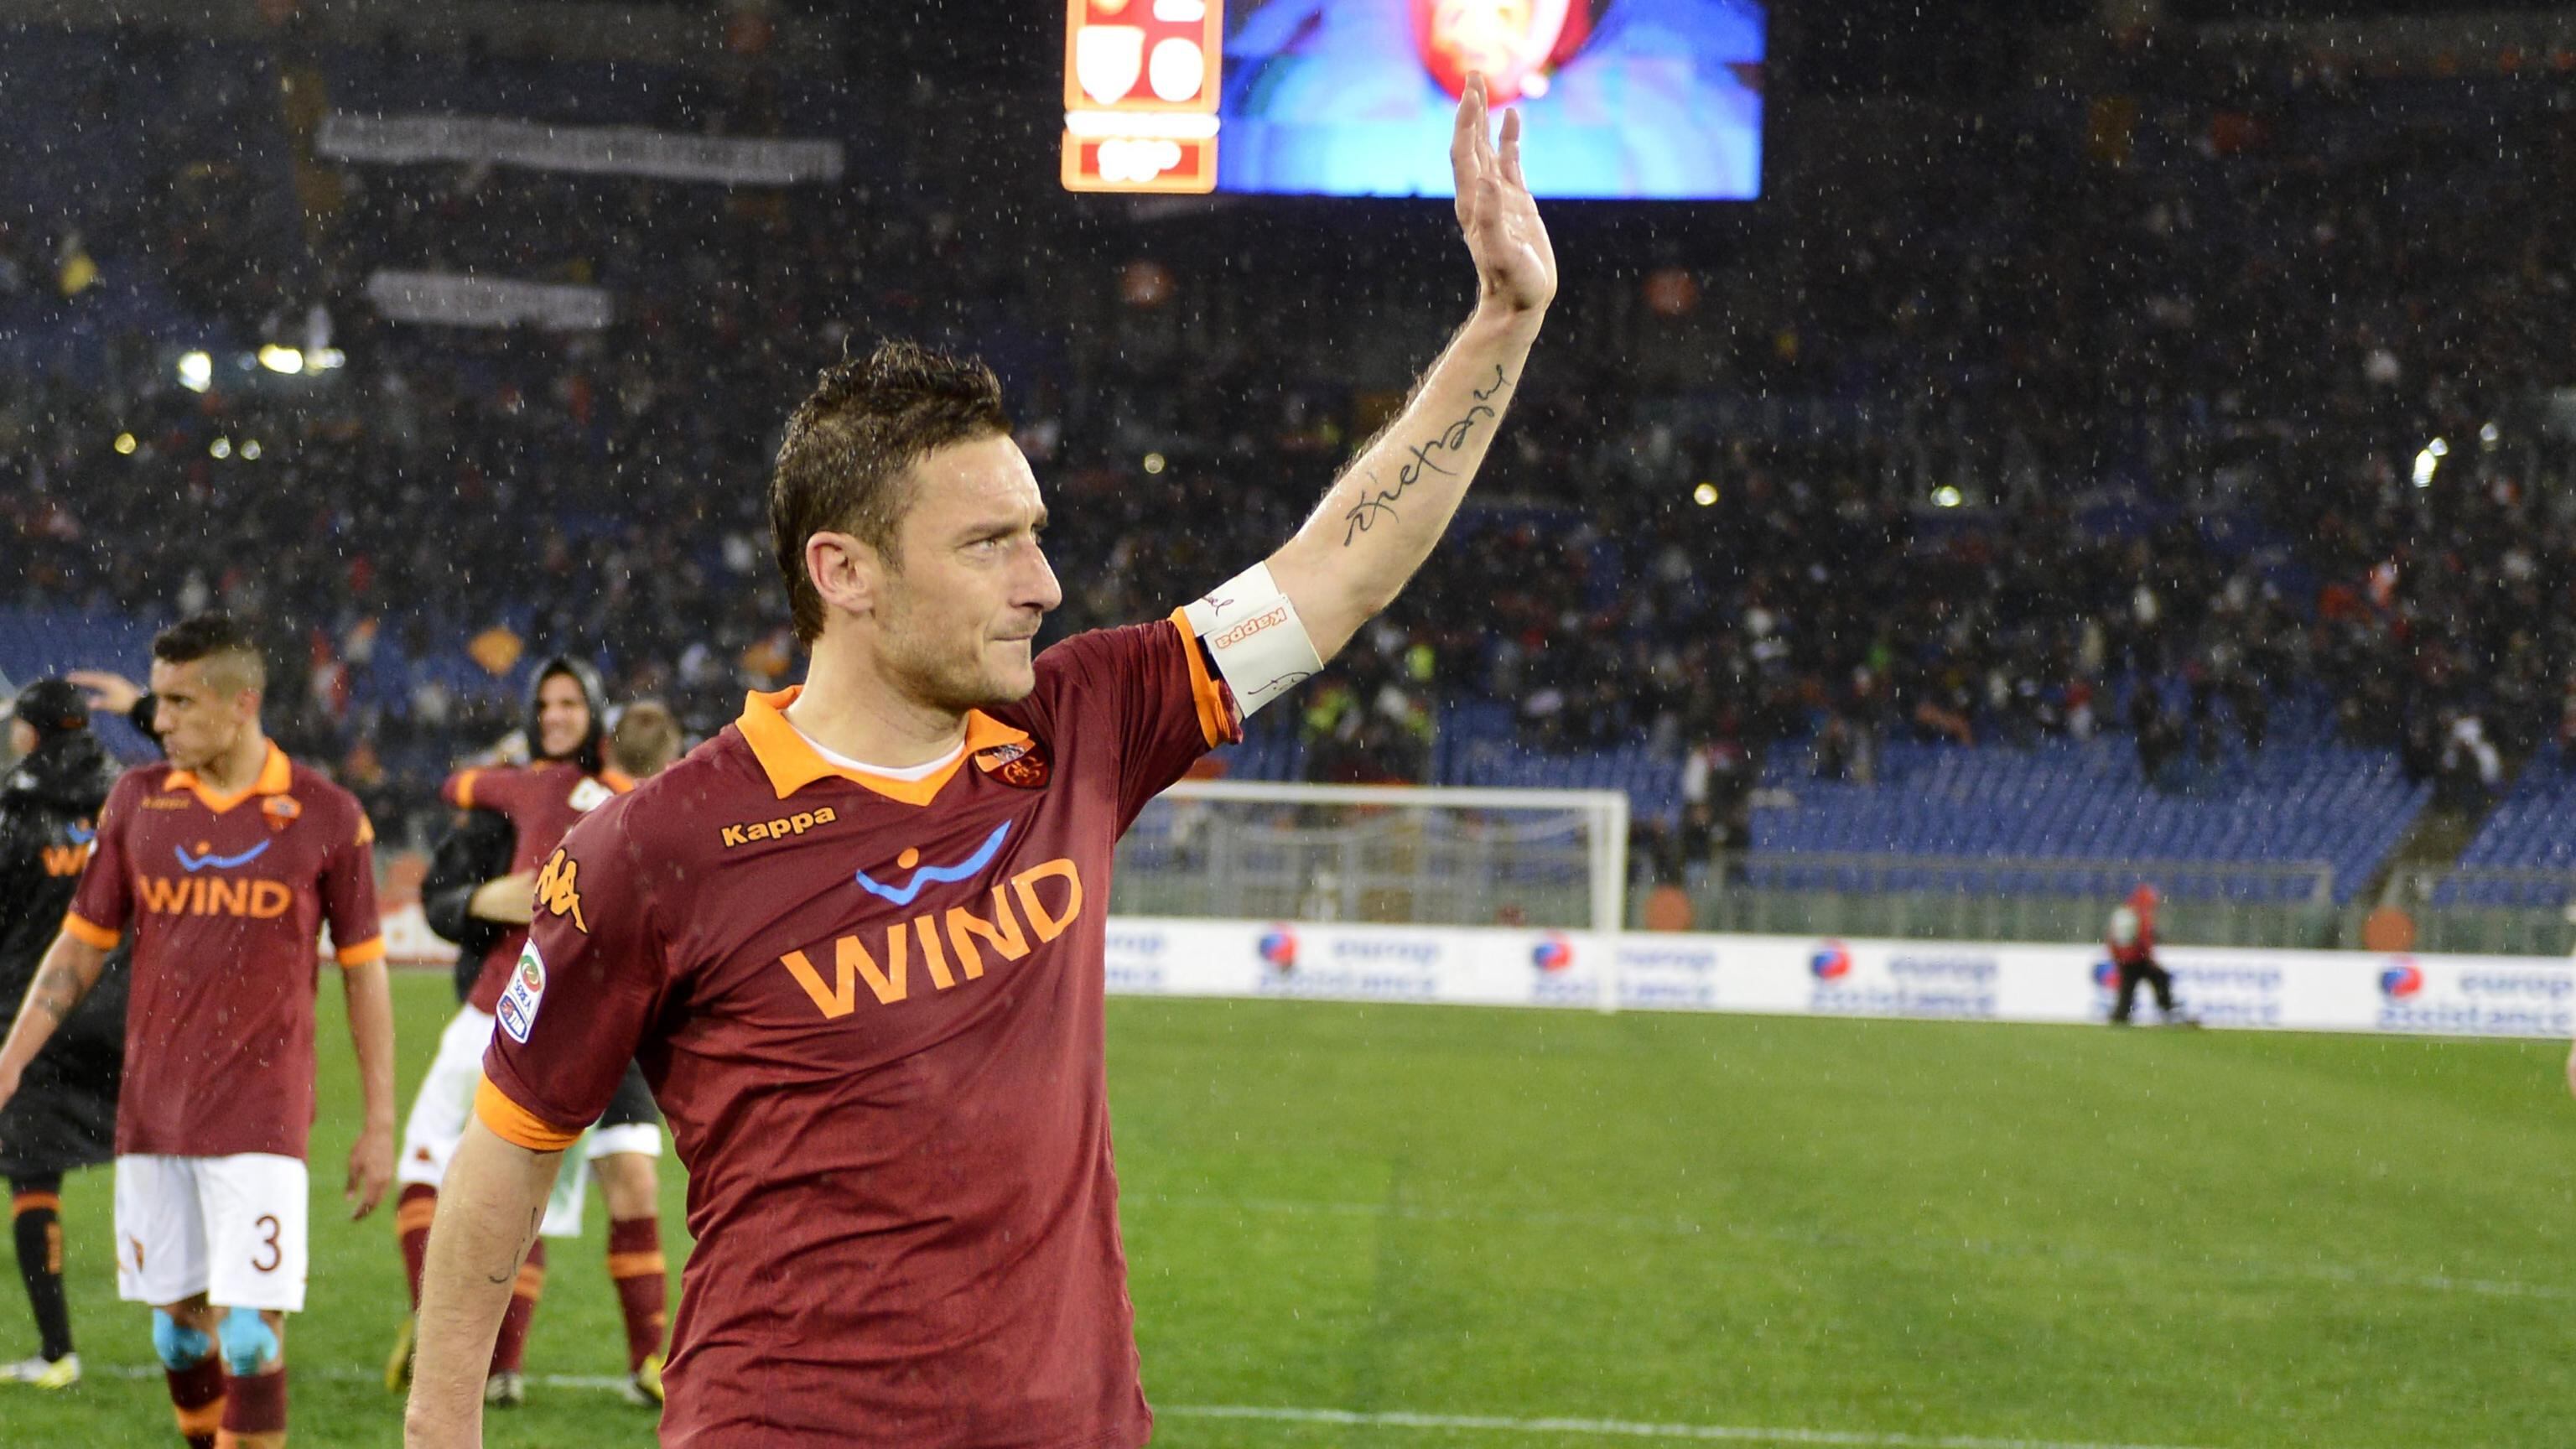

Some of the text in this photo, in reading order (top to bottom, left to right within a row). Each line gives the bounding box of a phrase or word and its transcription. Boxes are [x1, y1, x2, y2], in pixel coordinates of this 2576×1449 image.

[1214, 607, 1287, 649] Kappa
[719, 805, 837, 848] Kappa
[138, 875, 293, 919] WIND
[780, 857, 1083, 1020] WIND
[252, 1214, 282, 1272] 3
